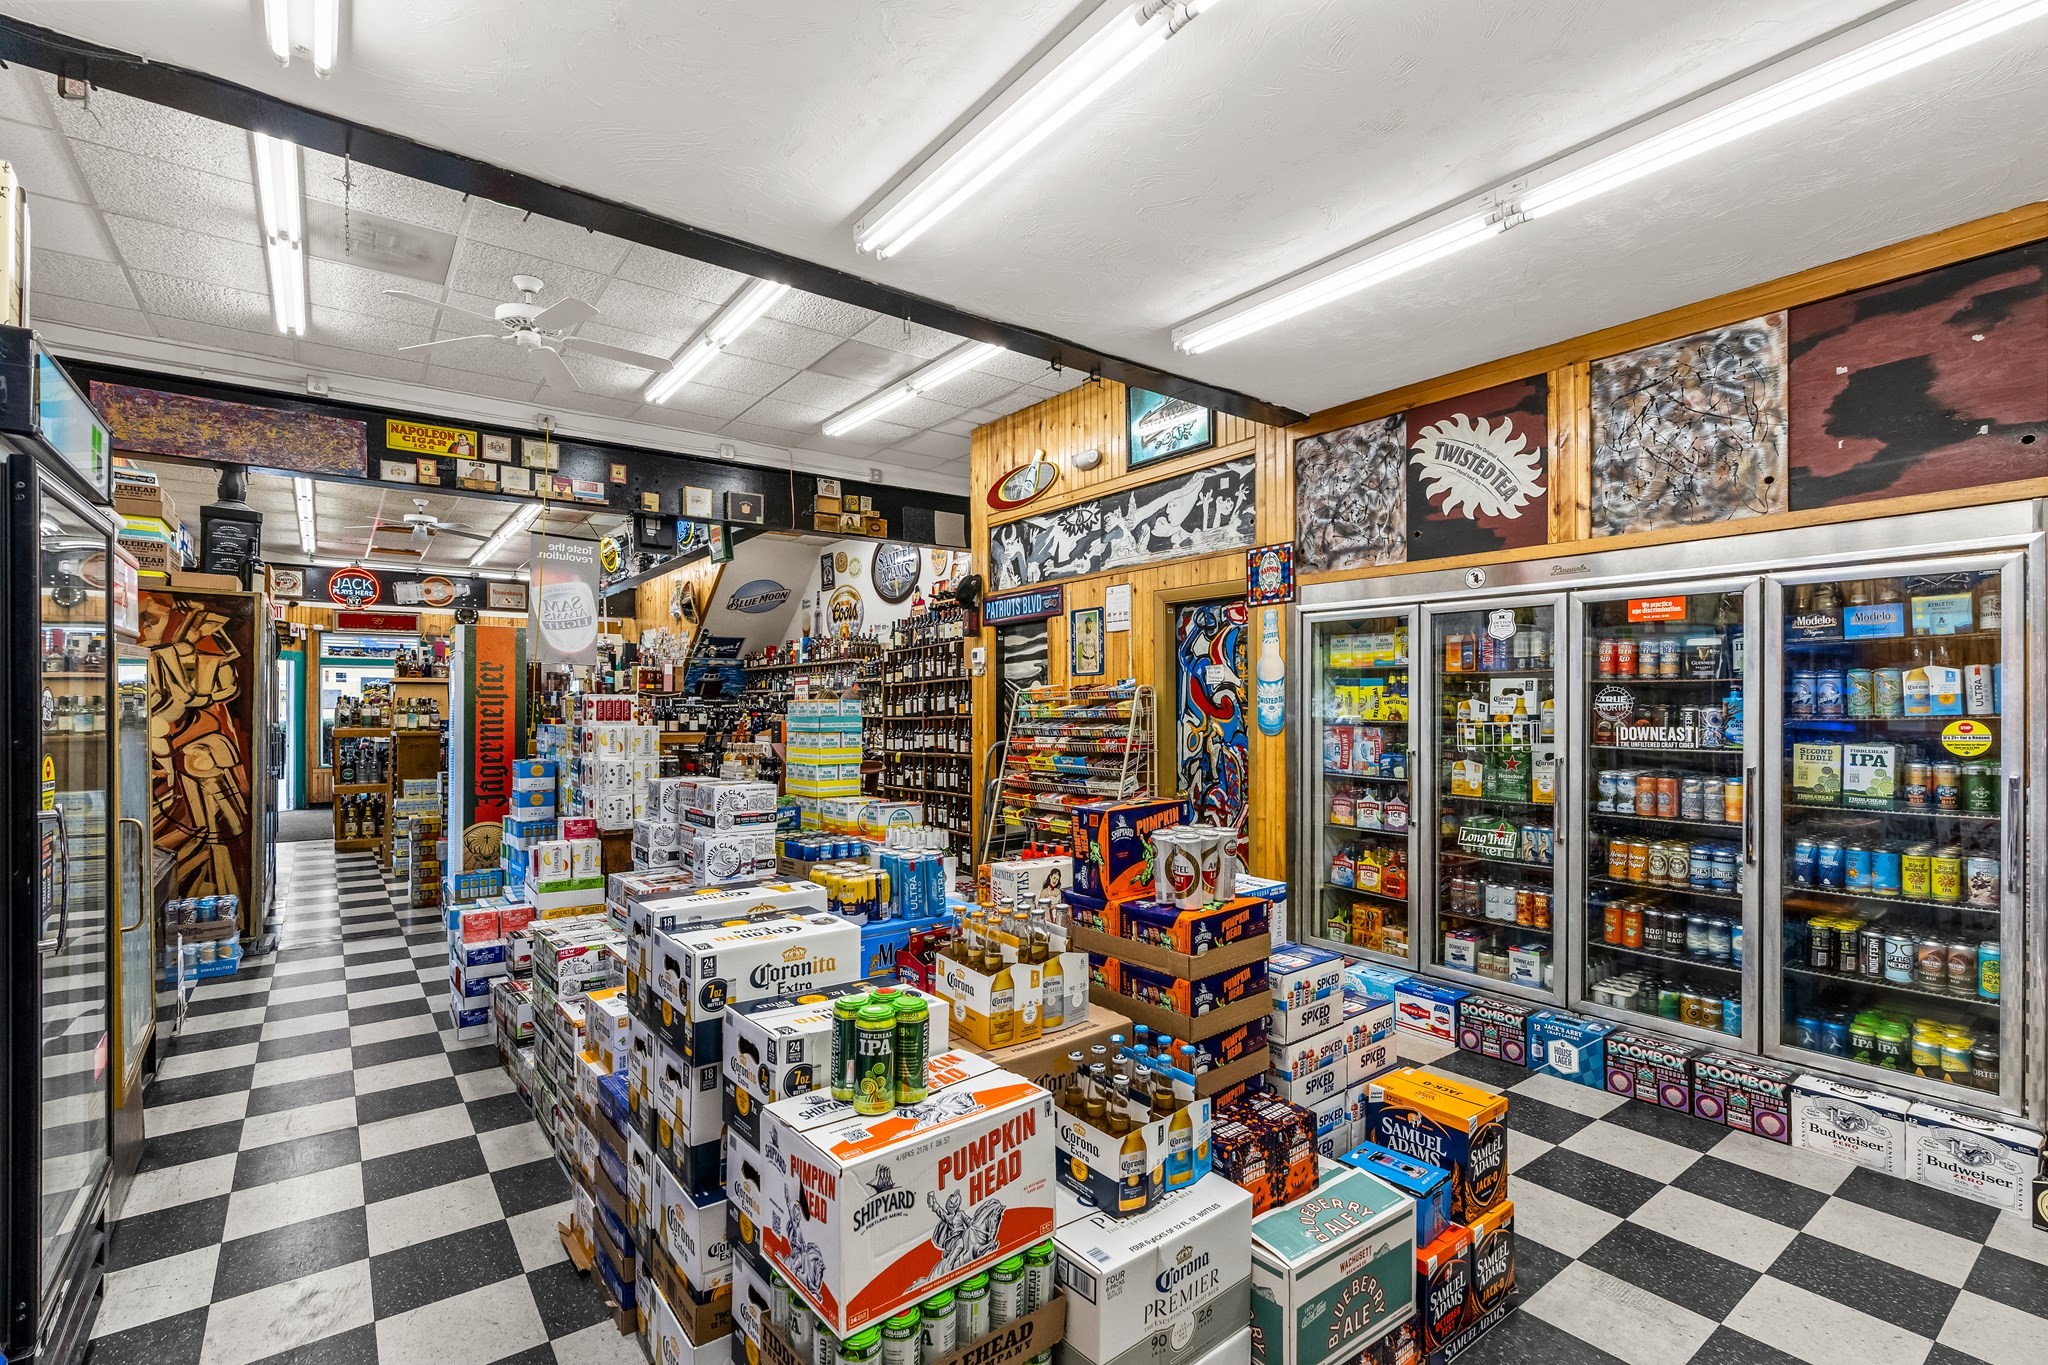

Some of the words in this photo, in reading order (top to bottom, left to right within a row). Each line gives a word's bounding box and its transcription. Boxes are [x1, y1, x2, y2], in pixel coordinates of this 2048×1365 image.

[390, 424, 456, 442] NAPOLEON
[402, 435, 447, 447] CIGAR
[1482, 447, 1498, 459] Original
[1434, 442, 1497, 480] TWISTED
[1490, 468, 1519, 502] TEA
[1456, 469, 1467, 477] Hard
[878, 546, 914, 571] SAMUEL
[881, 565, 912, 583] ADAMS
[332, 577, 373, 590] JACK
[729, 596, 759, 611] BLUE
[760, 591, 788, 602] MOON
[986, 597, 1021, 620] PATRIOTS
[1023, 594, 1042, 614] BLVD
[1650, 601, 1673, 609] practice
[832, 601, 859, 621] Coors
[1642, 606, 1682, 614] discrimination.
[1855, 611, 1891, 622] Modelo
[1796, 615, 1831, 626] Modelo
[1600, 695, 1628, 703] TRUE
[1975, 678, 1984, 707] ULTRA
[1601, 704, 1628, 712] NORTH
[1619, 727, 1694, 743] DOWNEAST
[1799, 747, 1833, 755] SECOND
[1799, 754, 1833, 762] FIDDLE
[1849, 754, 1888, 768] IPA
[716, 792, 727, 812] WHITE
[728, 789, 746, 800] CLAW
[1136, 806, 1179, 836] PUMPKIN
[1111, 829, 1134, 841] SHIPYARD
[1461, 830, 1487, 844] Long
[1488, 833, 1513, 846] Trail
[706, 845, 719, 867] WHITE
[720, 842, 739, 853] CLAW
[1608, 850, 1627, 860] Honey
[992, 870, 1015, 882] LAGUNITAS
[663, 917, 673, 927] 18
[1226, 926, 1242, 941] HEAD
[572, 957, 591, 966] CLAW
[703, 957, 714, 968] 24
[1080, 957, 1085, 965] 6
[1513, 957, 1535, 966] DOWNEAST
[1887, 962, 1912, 970] NERD
[749, 955, 837, 990] Coronita
[899, 967, 920, 982] Prestige
[658, 973, 678, 998] Coronita
[954, 989, 967, 1002] Light
[1400, 1004, 1417, 1015] Happy
[1417, 1009, 1430, 1018] Dad
[1460, 1002, 1525, 1027] BOOMBOX
[860, 1031, 893, 1039] IMPERIAL
[1533, 1023, 1541, 1031] 12
[1544, 1024, 1564, 1035] JACK'S
[1564, 1028, 1583, 1037] ABBY
[1546, 1030, 1563, 1038] CRAFT
[790, 1041, 801, 1052] 24
[1852, 1038, 1874, 1049] IPA
[1877, 1044, 1900, 1055] IPA
[1553, 1046, 1573, 1059] HOUSE
[1607, 1040, 1687, 1073] BOOMBOX
[730, 1056, 757, 1085] Coronita
[1553, 1056, 1573, 1068] LAGER
[703, 1069, 714, 1079] 18
[1694, 1062, 1787, 1099] BOOMBOX
[1423, 1081, 1464, 1096] JACK-O
[1060, 1124, 1101, 1158] Corona
[1381, 1116, 1448, 1157] SAMUEL
[1809, 1122, 1884, 1152] Budweiser
[1832, 1139, 1859, 1150] ZERO
[896, 1149, 915, 1162] 4/6PKS
[916, 1145, 929, 1156] 2176
[938, 1107, 1037, 1191] PUMPKIN
[1070, 1145, 1090, 1163] Extra
[1387, 1136, 1441, 1168] ADAMS
[1470, 1134, 1504, 1168] SAMUEL
[764, 1144, 787, 1176] SHIPYARD
[1121, 1158, 1146, 1171] Corona
[1473, 1150, 1500, 1182] ADAMS
[791, 1154, 836, 1201] PUMPKIN
[969, 1149, 1022, 1206] HEAD
[1926, 1154, 2014, 1189] Budweiser
[1953, 1174, 1984, 1186] ZERO
[1475, 1171, 1498, 1194] JACK-O
[853, 1190, 917, 1233] SHIPYARD
[865, 1216, 889, 1231] PORTLAND
[888, 1211, 903, 1220] MAINE
[1129, 1241, 1144, 1253] FOUR
[1166, 1227, 1174, 1236] OF
[1198, 1203, 1221, 1218] BOTTLES
[1300, 1198, 1375, 1244] BLUEBERRY
[1324, 1212, 1361, 1237] ALE
[1340, 1245, 1373, 1274] WACHUSETT
[1477, 1241, 1510, 1278] SAMUEL
[1106, 1270, 1126, 1285] FOUR
[1156, 1251, 1210, 1294] Corona
[1346, 1264, 1362, 1276] BREWING
[1480, 1257, 1507, 1291] ADAMS
[1106, 1279, 1126, 1293] 6-PACKS
[1430, 1270, 1467, 1311] SAMUEL
[1482, 1278, 1505, 1302] JACK-O
[1144, 1268, 1220, 1325] PREMIER
[1154, 1306, 1192, 1330] EXCEPTIONAL
[1192, 1296, 1208, 1309] LIGHT
[1207, 1287, 1219, 1298] BEER
[1199, 1304, 1213, 1324] 2.6
[1328, 1275, 1385, 1349] BLUEBERRY
[1433, 1288, 1463, 1325] ADAMS
[714, 1312, 732, 1323] TWO
[1343, 1303, 1371, 1339] ALE
[1436, 1306, 1460, 1332] OCTOBER
[1441, 1321, 1455, 1338] FEST
[1151, 1334, 1168, 1351] 90
[1444, 1327, 1478, 1363] SAMUEL
